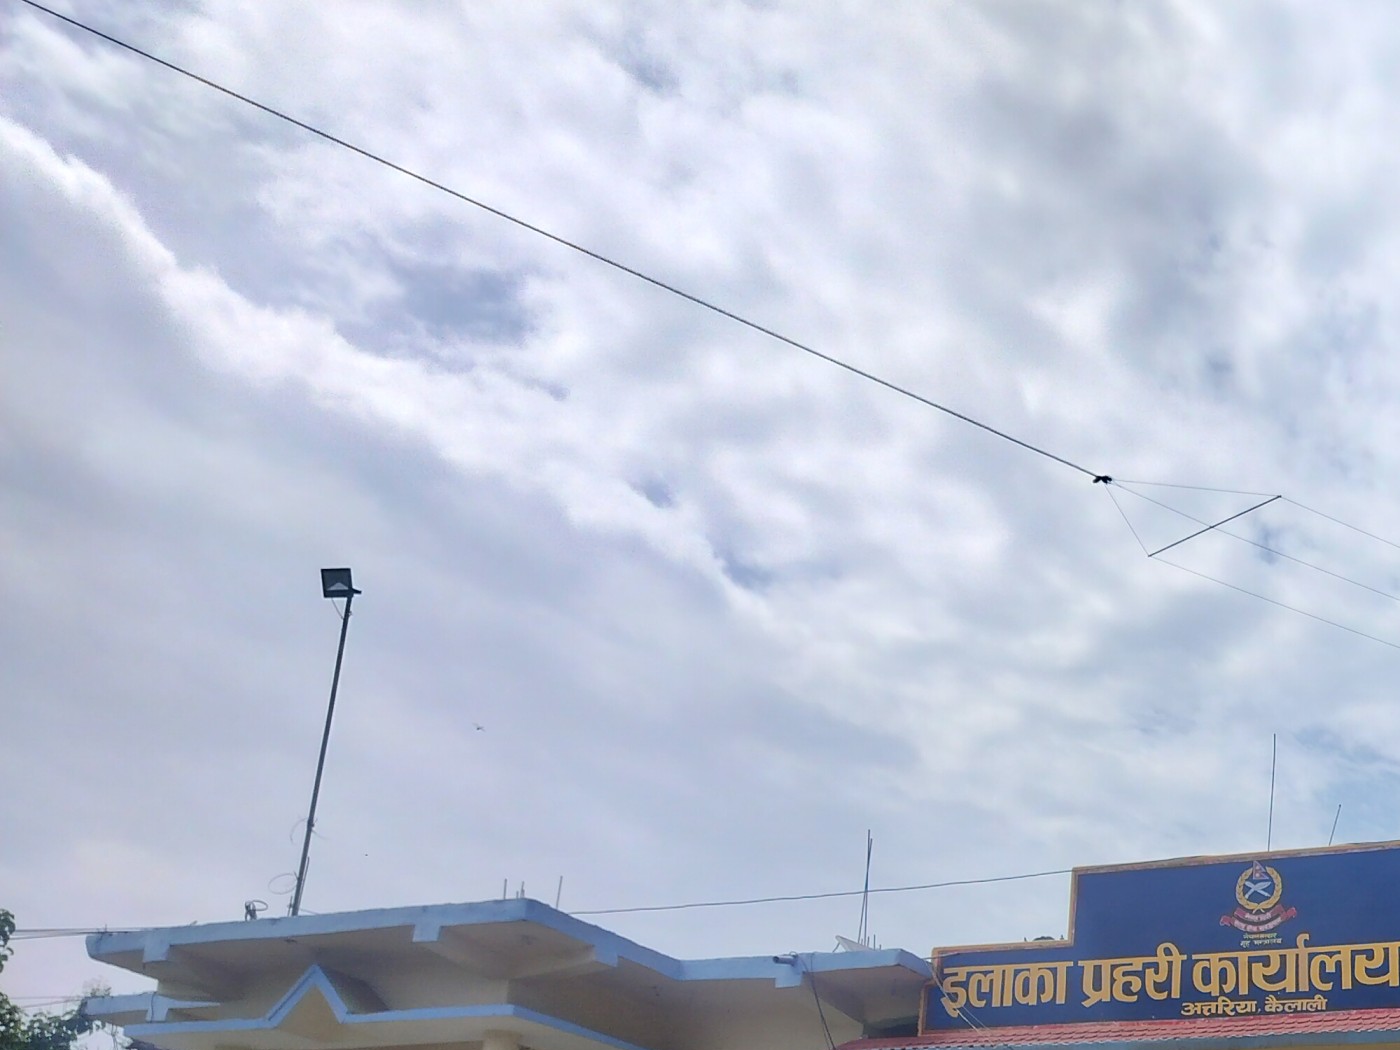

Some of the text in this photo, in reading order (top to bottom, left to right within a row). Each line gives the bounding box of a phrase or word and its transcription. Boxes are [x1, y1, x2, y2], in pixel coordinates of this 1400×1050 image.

[940, 960, 1074, 1017] इलाका
[1080, 942, 1186, 1008] प्रहरी
[1265, 995, 1328, 1013] कैलाली
